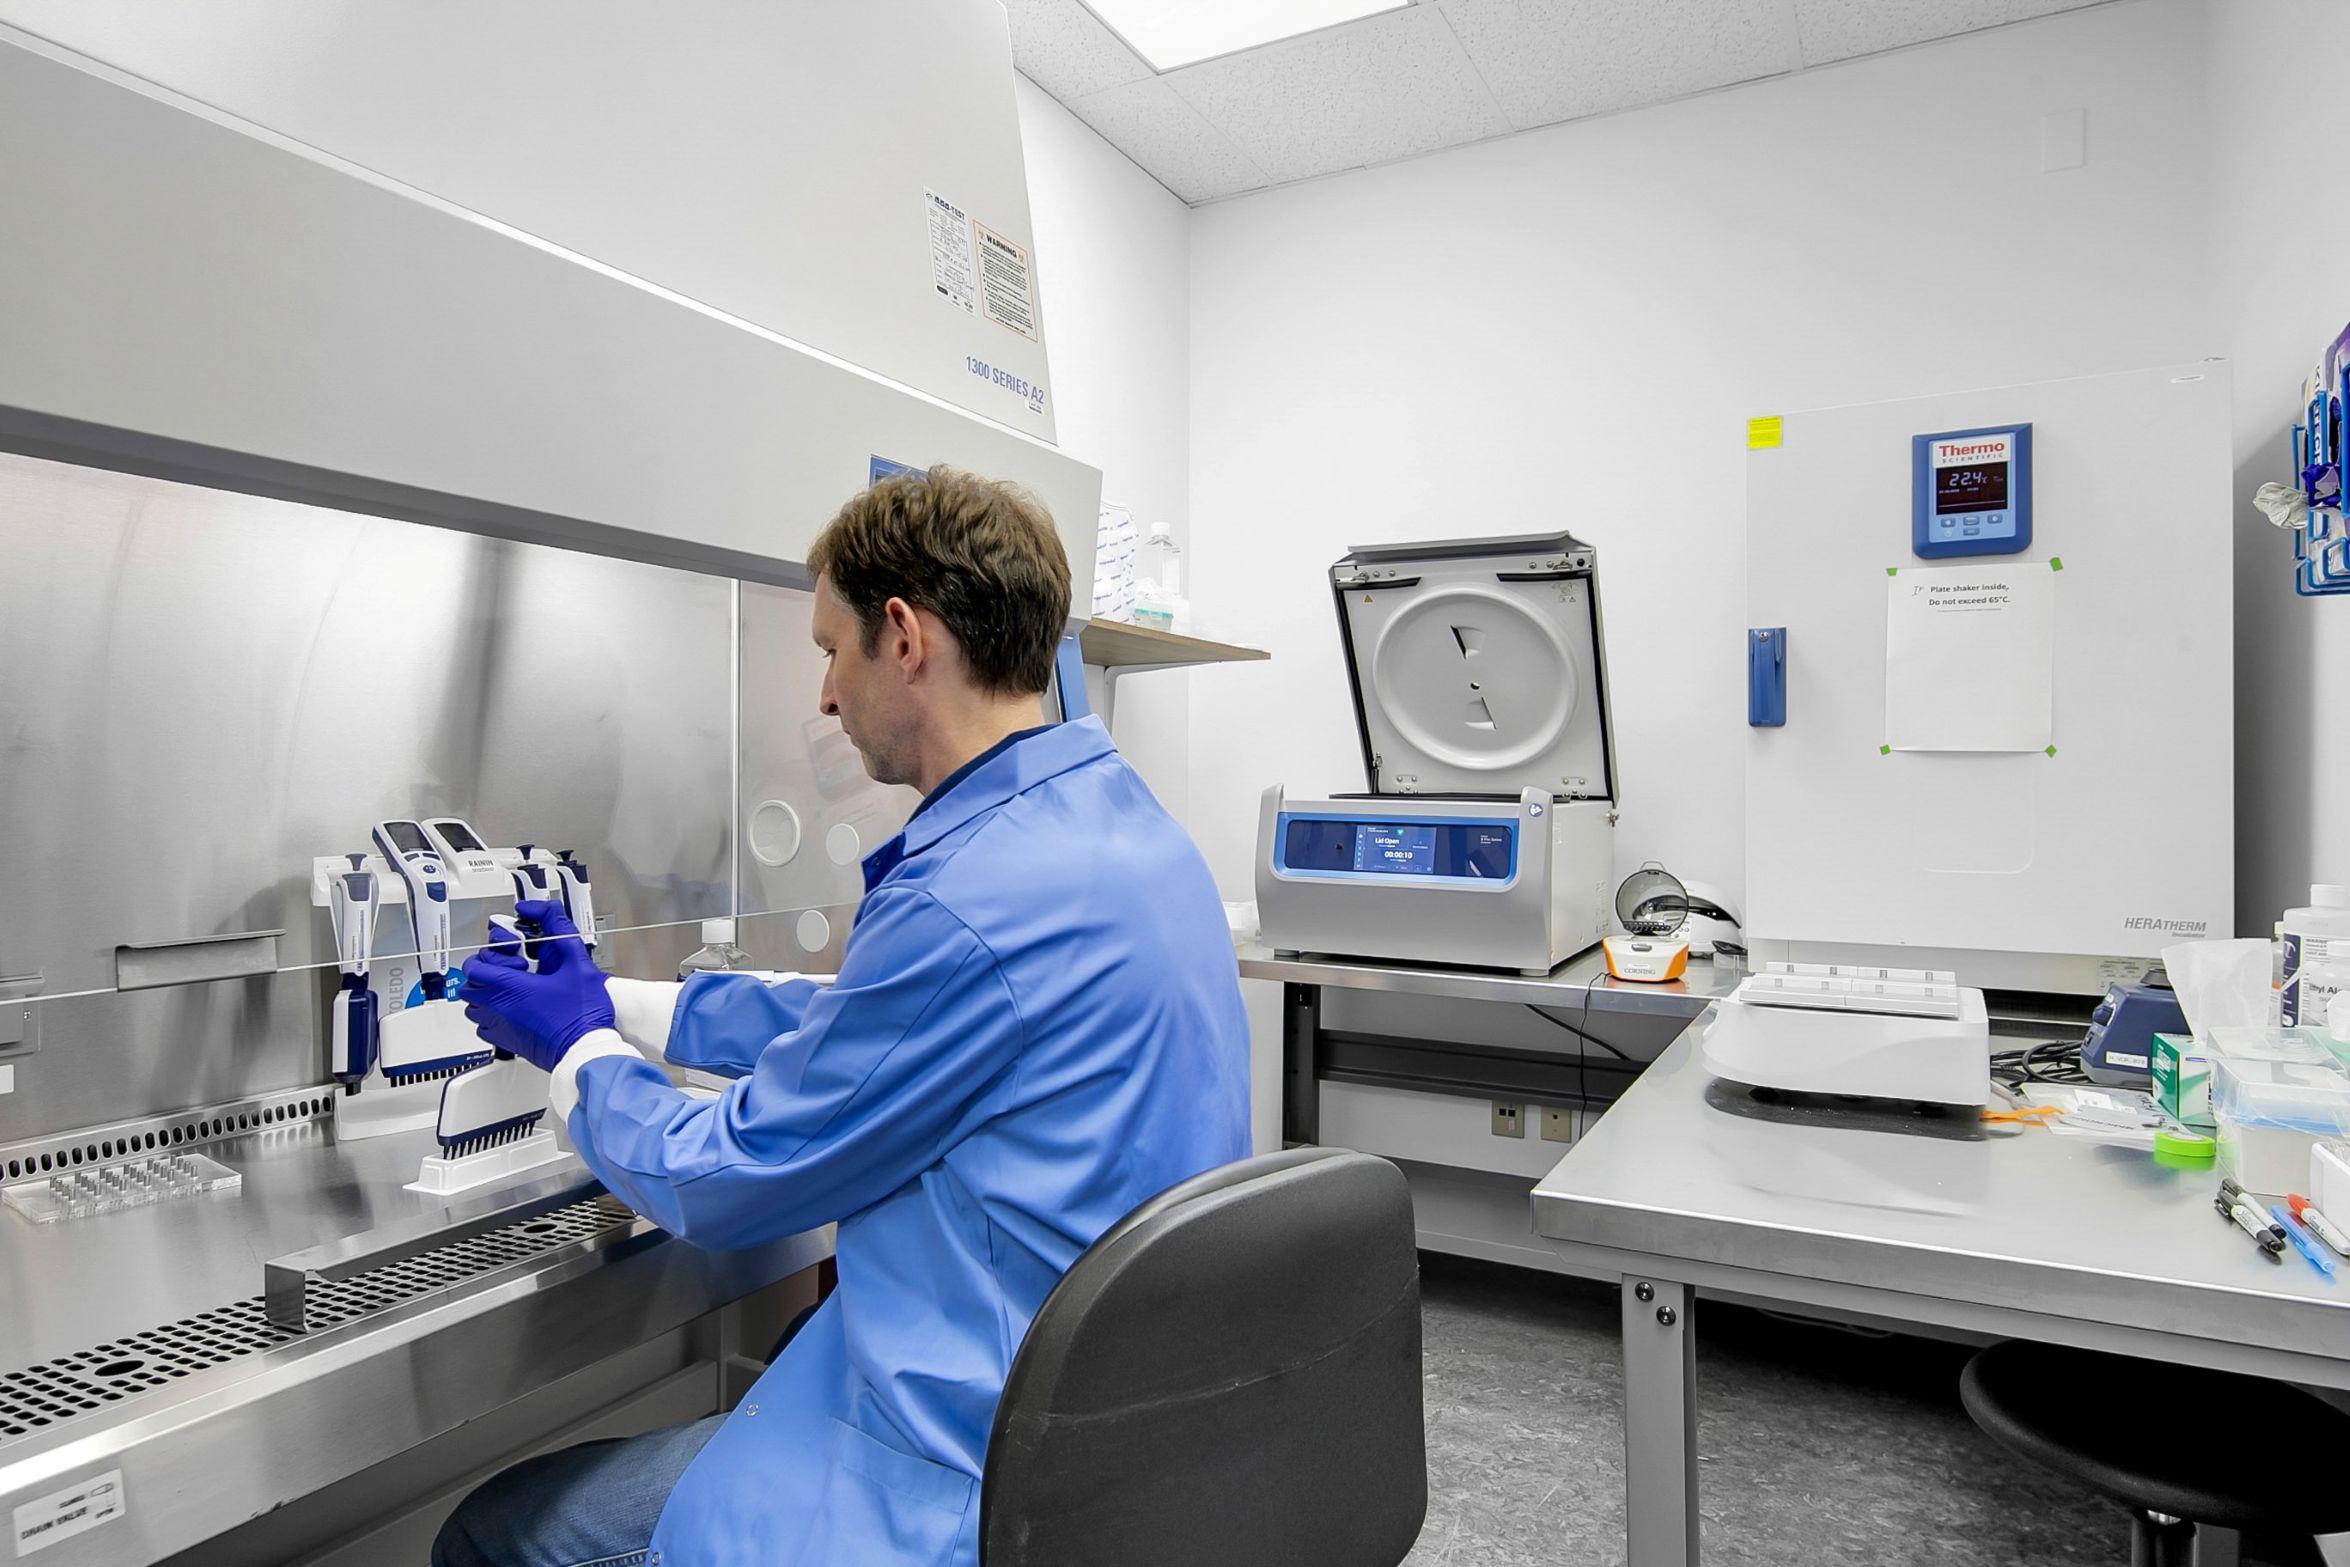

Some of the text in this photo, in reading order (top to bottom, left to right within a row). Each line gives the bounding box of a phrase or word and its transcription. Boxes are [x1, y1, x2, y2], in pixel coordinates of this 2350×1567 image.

[986, 234, 1017, 257] WARNING
[966, 355, 1044, 404] 1300 SERIES A2
[1939, 443, 2005, 457] Thermo
[1942, 453, 2004, 463] SCIENTIFIC
[1953, 584, 1980, 592] shaker
[1982, 583, 2010, 592] inside,
[1958, 597, 1987, 605] exceed
[1385, 837, 1400, 845] Open
[1384, 850, 1413, 859] 00:00:10
[2124, 917, 2207, 932] HERATHERM
